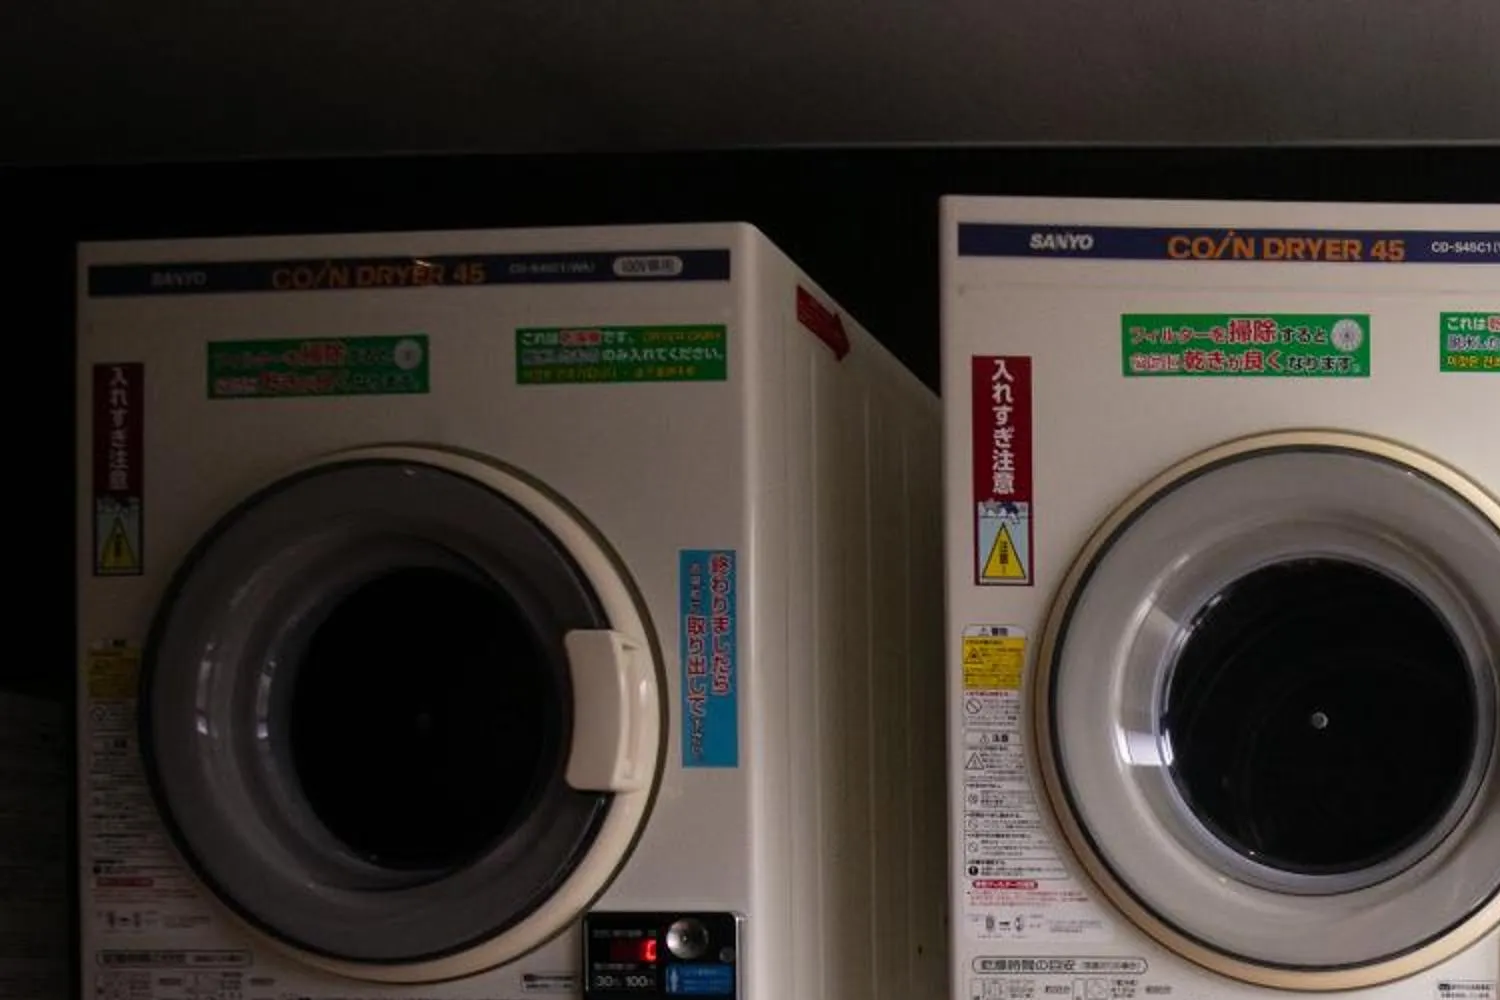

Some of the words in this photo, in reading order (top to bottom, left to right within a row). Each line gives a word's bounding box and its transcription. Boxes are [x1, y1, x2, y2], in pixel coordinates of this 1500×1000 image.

[1030, 233, 1094, 250] SANYO
[1262, 236, 1363, 262] DRYER
[1370, 237, 1406, 263] 45
[356, 264, 445, 287] DRYER
[451, 263, 486, 284] 45
[991, 359, 1015, 495] 入れすぎ注意
